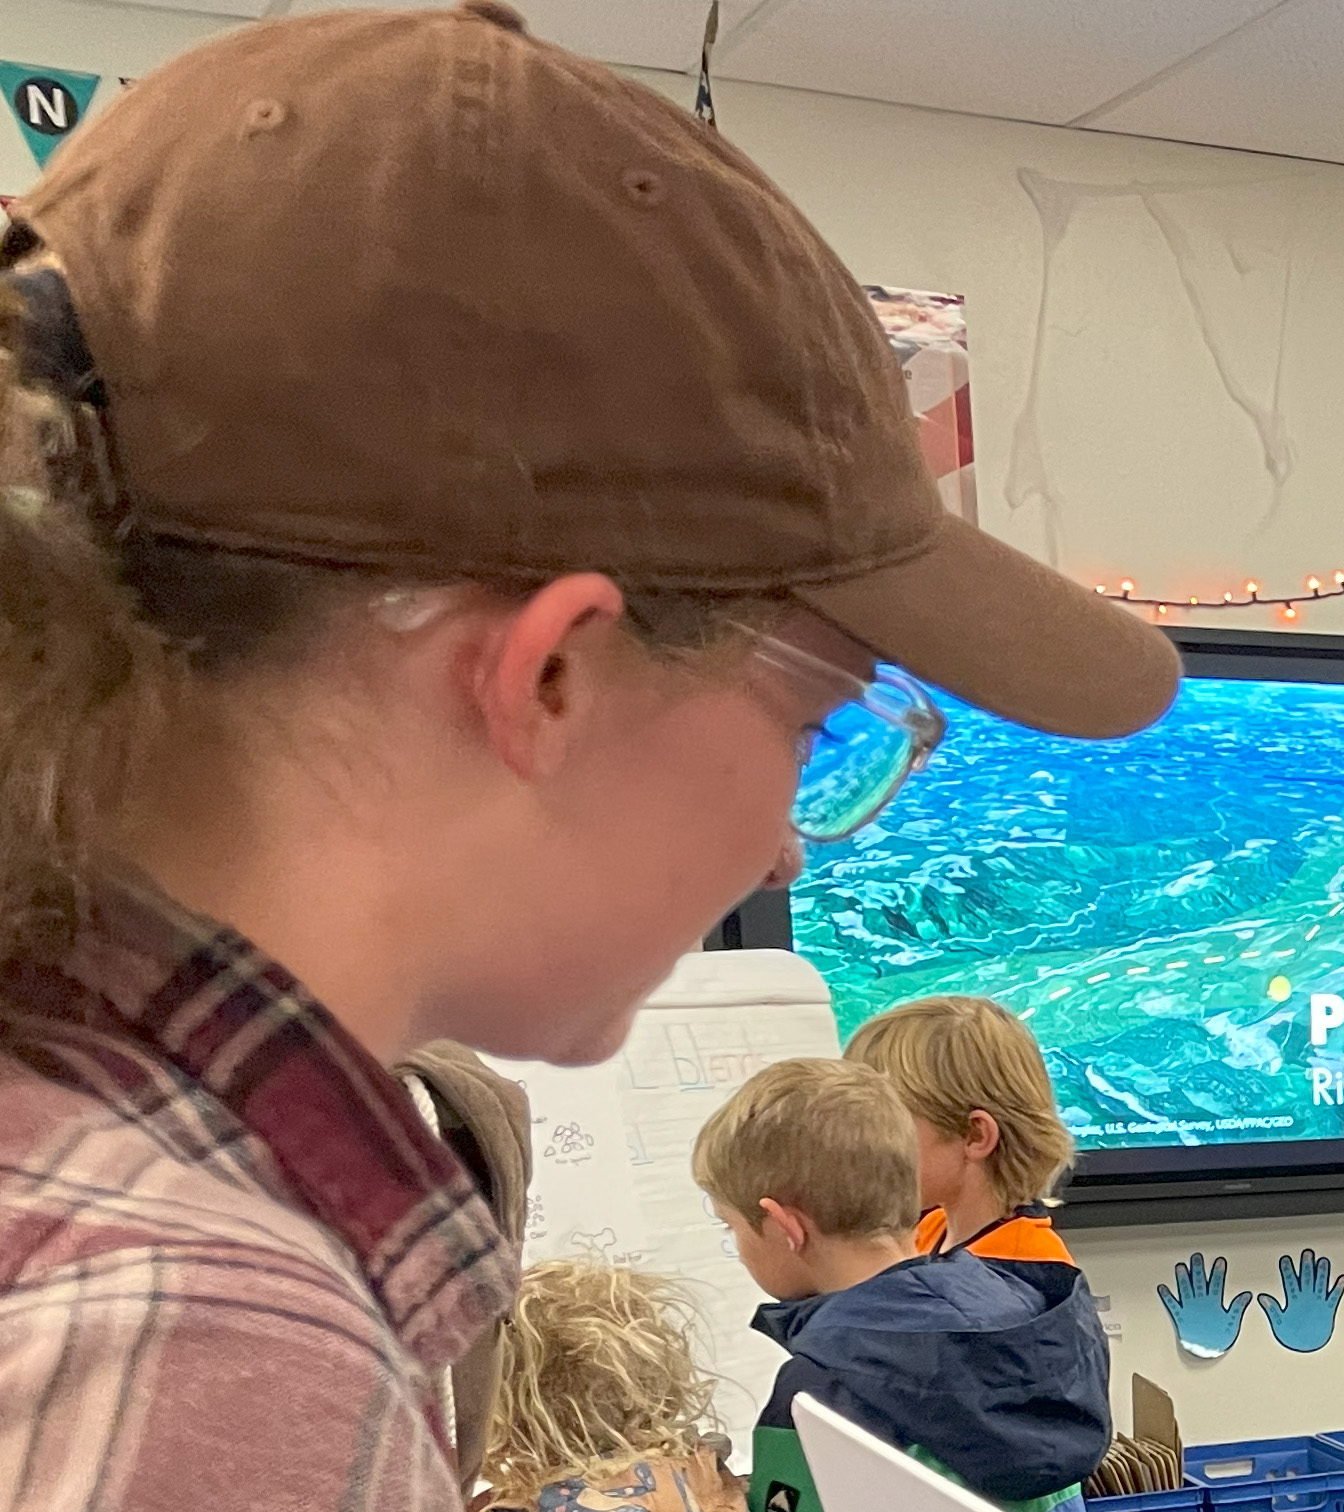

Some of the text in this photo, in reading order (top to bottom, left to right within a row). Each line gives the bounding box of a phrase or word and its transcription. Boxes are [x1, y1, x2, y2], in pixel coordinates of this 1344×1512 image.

[26, 84, 67, 128] N
[1105, 1123, 1127, 1134] U.S.
[1178, 1120, 1215, 1132] Survey,
